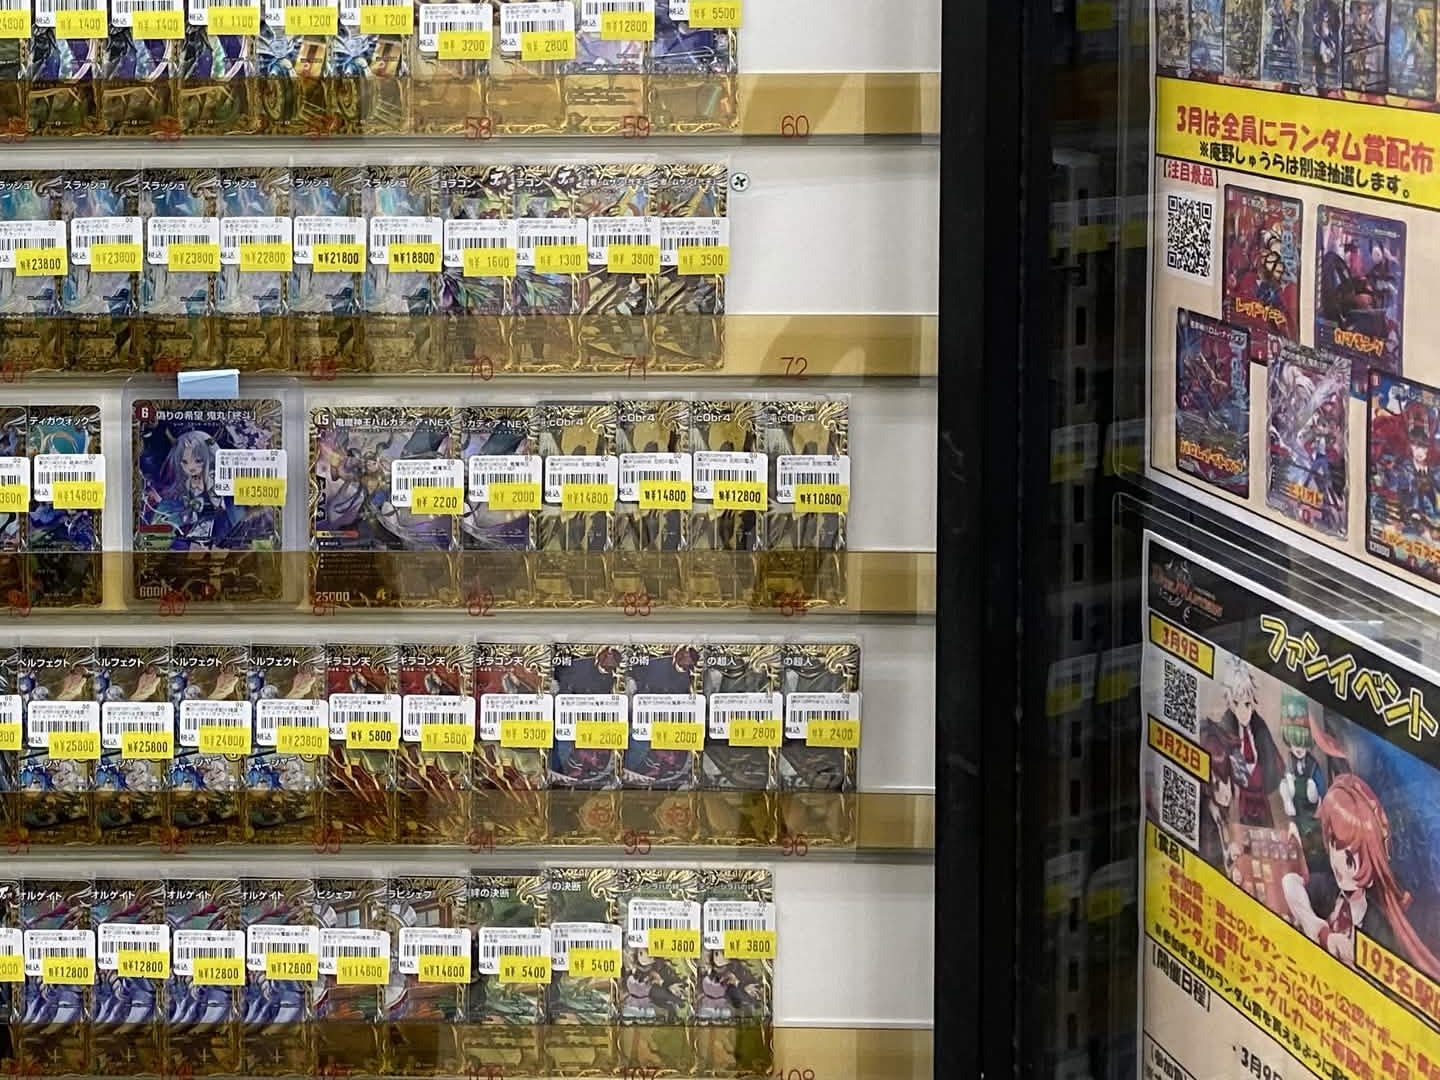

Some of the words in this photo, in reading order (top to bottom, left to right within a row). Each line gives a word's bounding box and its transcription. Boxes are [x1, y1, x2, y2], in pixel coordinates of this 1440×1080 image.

[781, 115, 809, 138] 60
[1176, 105, 1435, 176] 3月は全員にランダム賞配布
[782, 358, 807, 379] 72
[1260, 614, 1439, 742] ファンイベント
